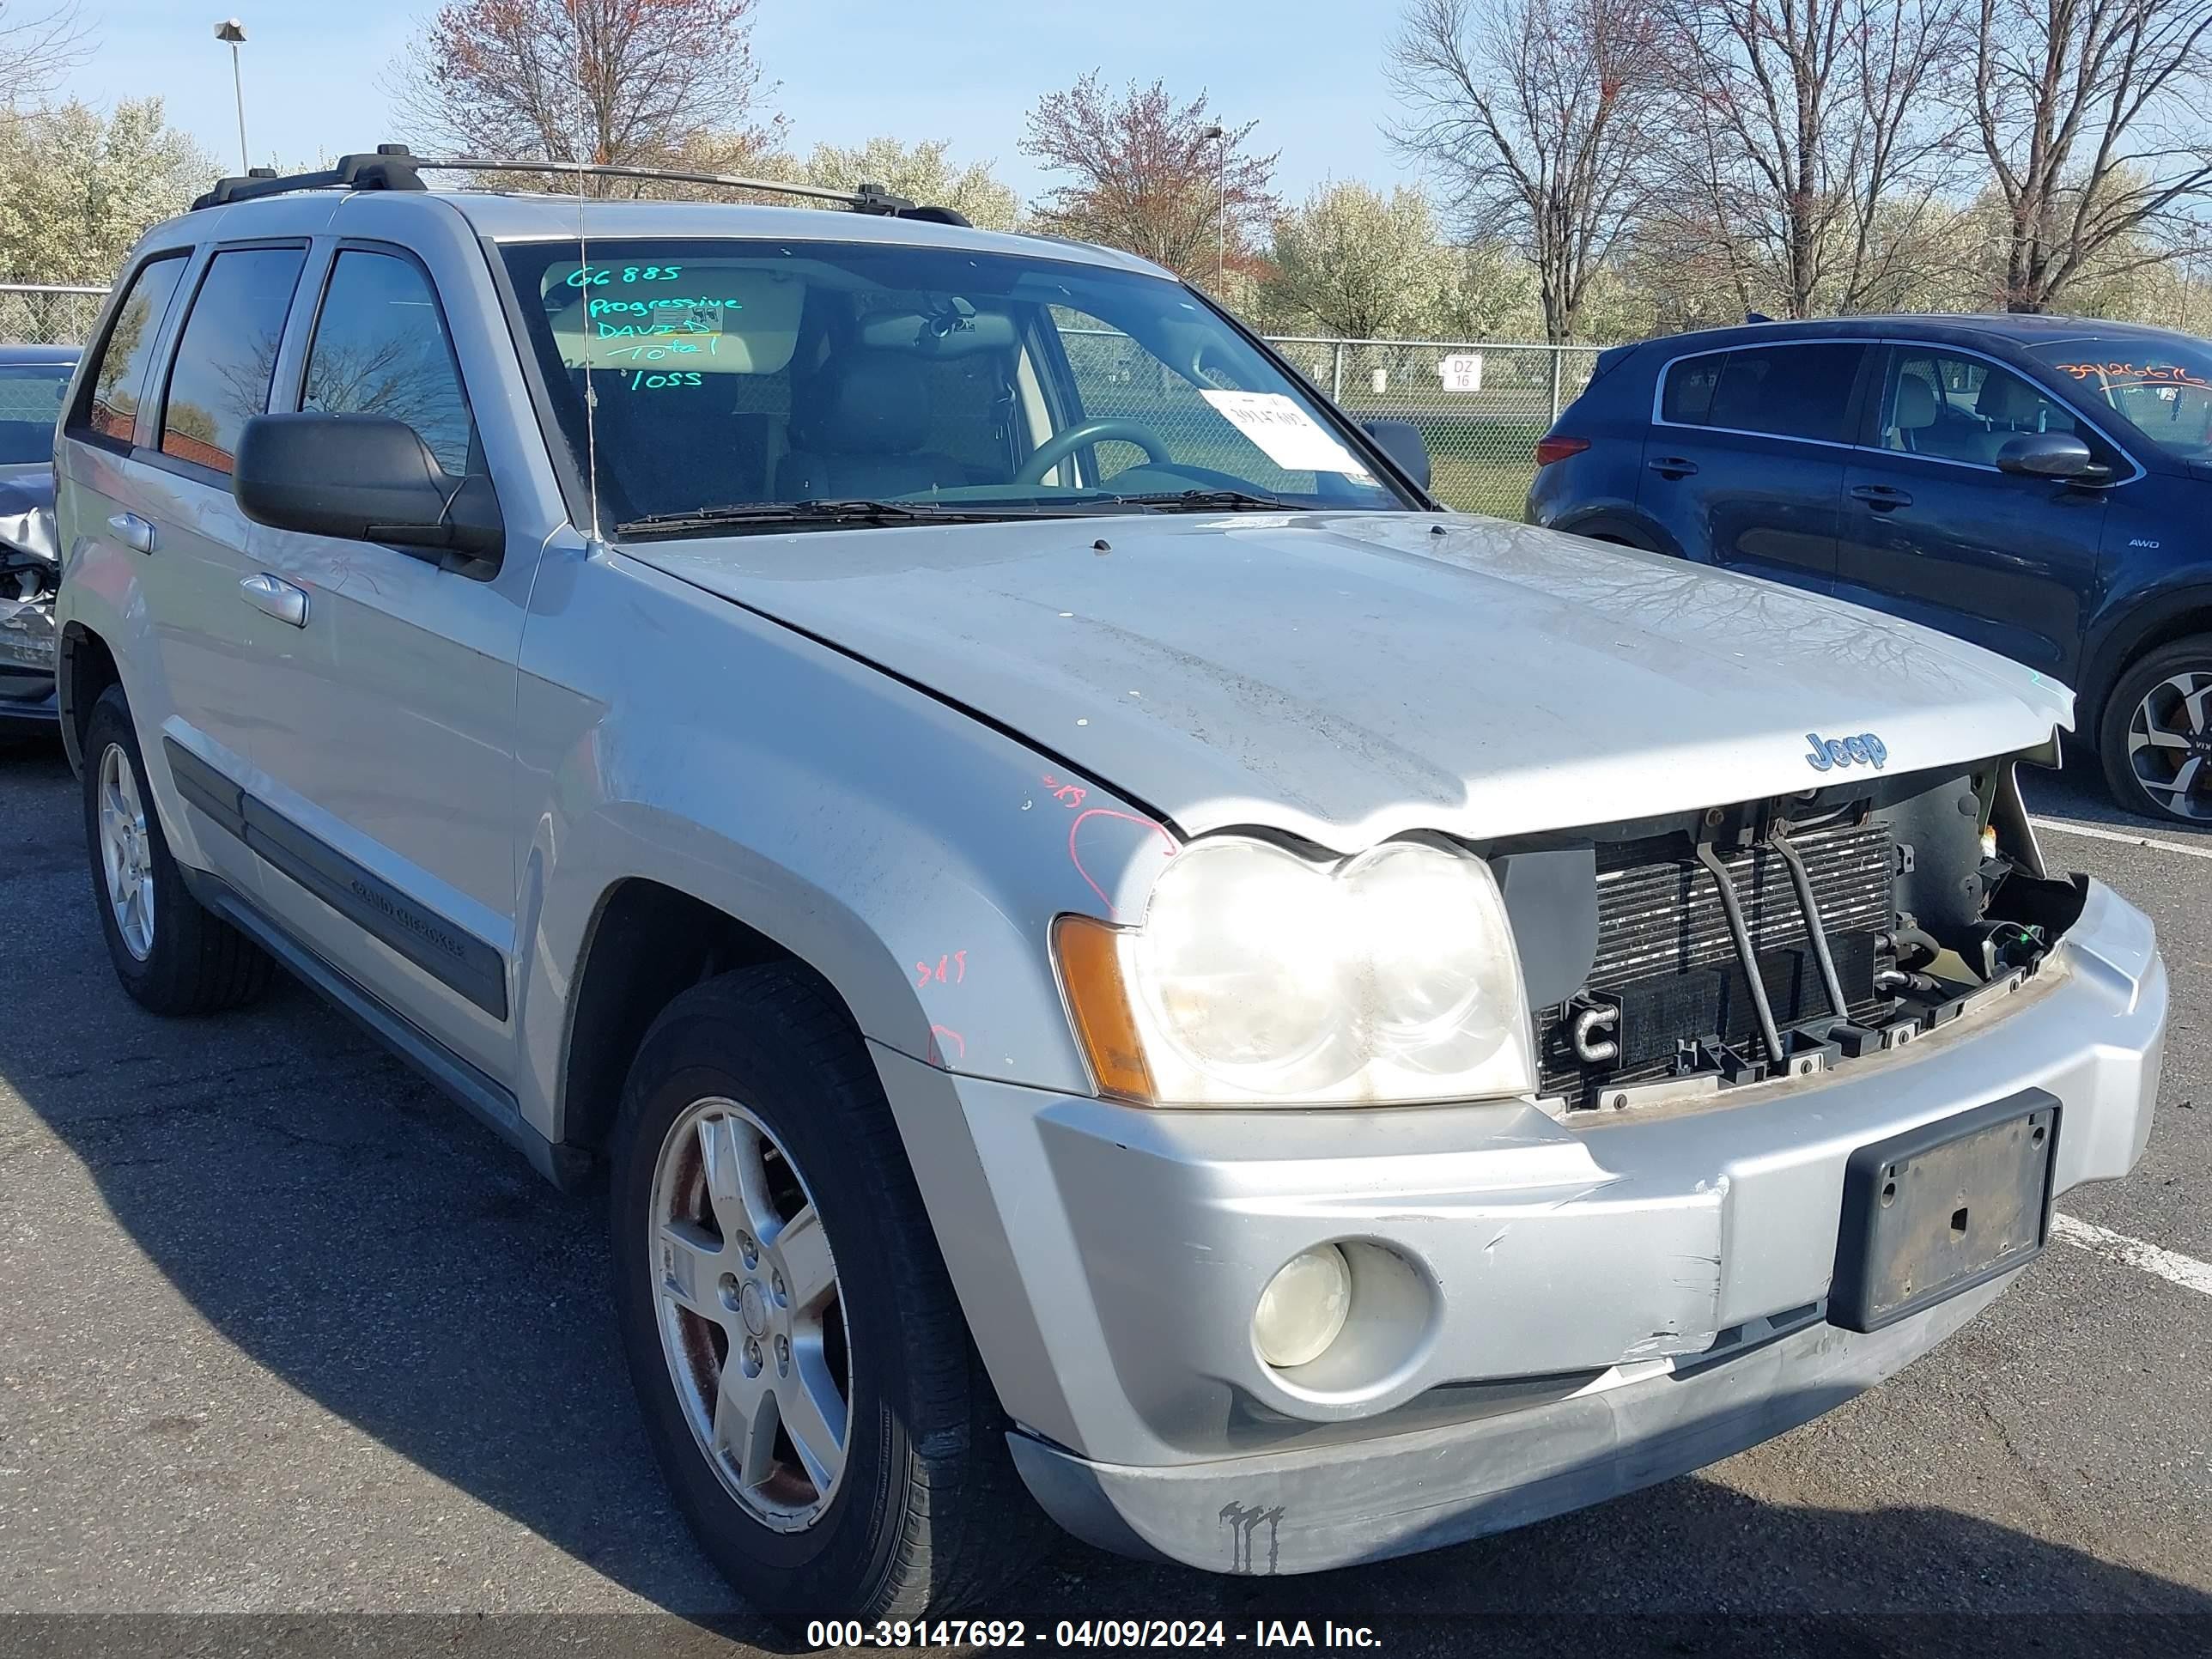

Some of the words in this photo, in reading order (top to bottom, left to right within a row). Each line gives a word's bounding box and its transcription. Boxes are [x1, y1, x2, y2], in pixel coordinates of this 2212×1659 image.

[623, 266, 683, 283] 885
[1454, 360, 1474, 373] DZ
[1456, 374, 1469, 386] 16
[2128, 538, 2160, 549] AWD
[1805, 732, 1887, 772] Jeep
